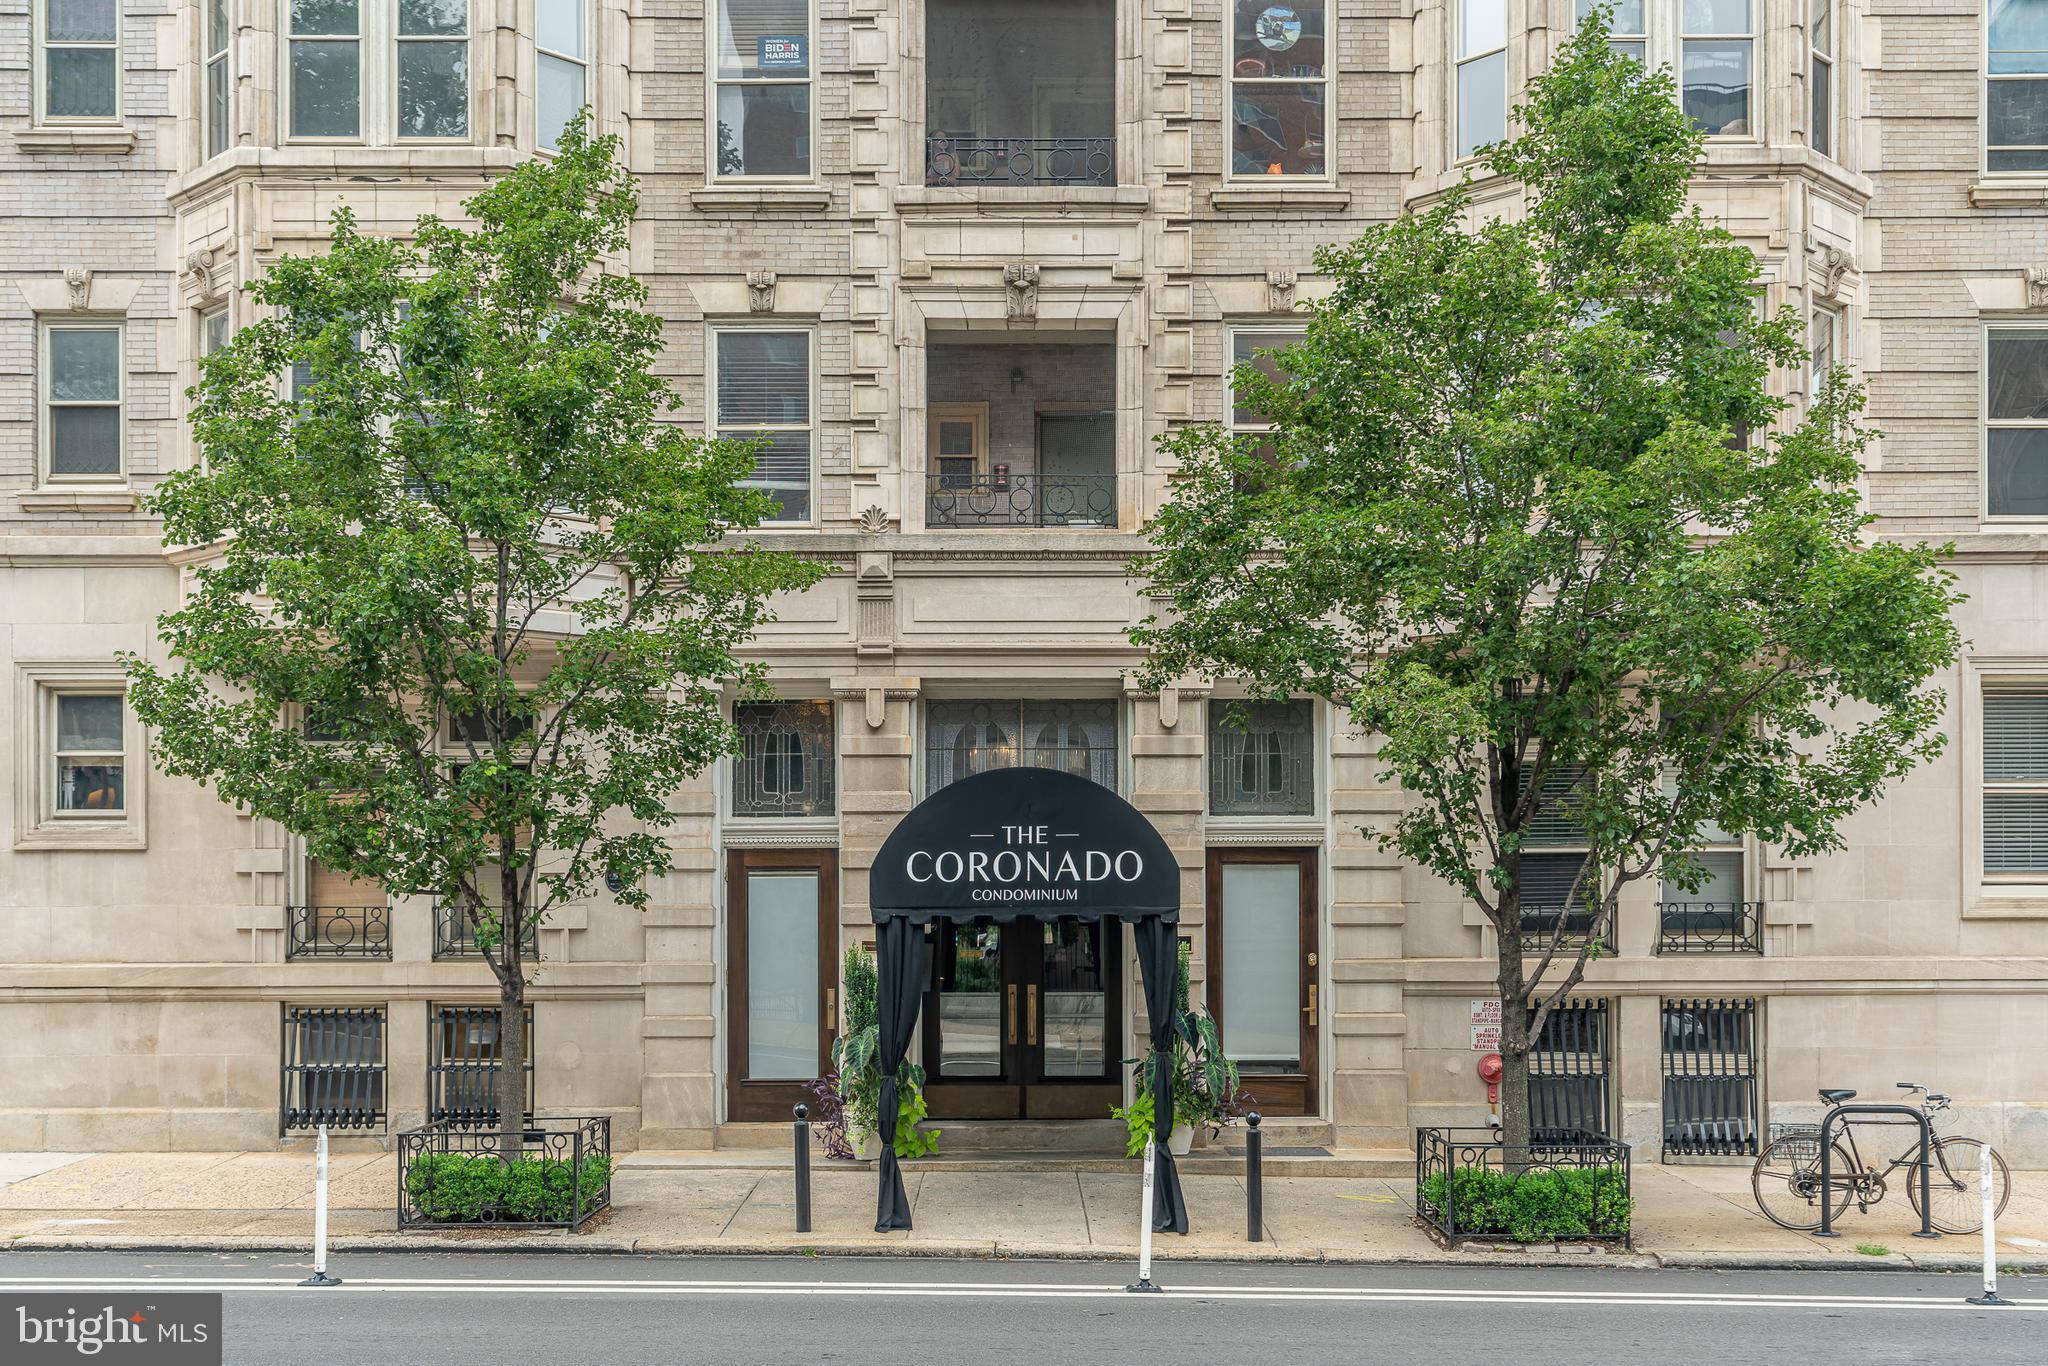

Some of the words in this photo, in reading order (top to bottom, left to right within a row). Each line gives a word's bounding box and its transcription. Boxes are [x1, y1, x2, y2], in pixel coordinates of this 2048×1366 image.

[765, 43, 799, 52] BIDEN
[1001, 825, 1048, 844] THE
[906, 850, 1144, 882] CORONADO
[971, 888, 1078, 901] CONDOMINIUM
